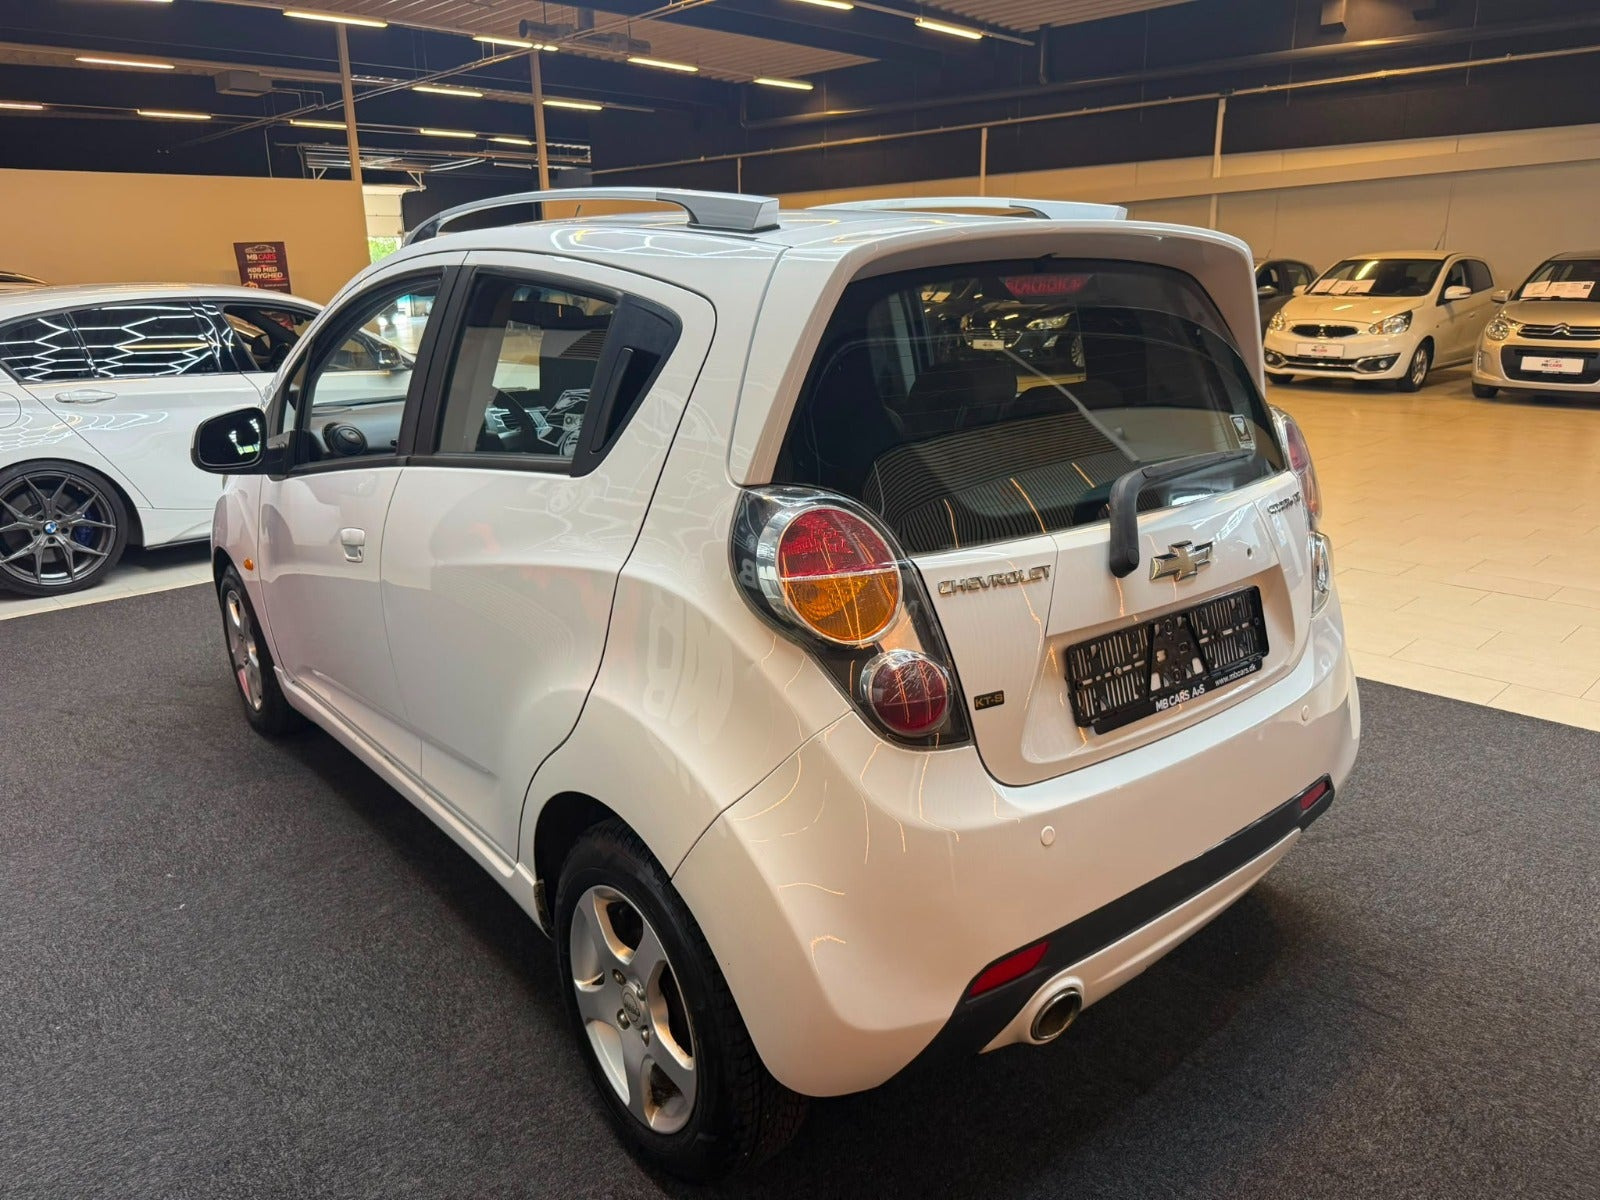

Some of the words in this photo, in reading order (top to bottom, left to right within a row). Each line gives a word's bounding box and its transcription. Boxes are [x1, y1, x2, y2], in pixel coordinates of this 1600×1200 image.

[937, 564, 1051, 595] CHEVROLET
[1214, 665, 1257, 687] www.mbcars.dk
[1155, 698, 1169, 712] MB
[1168, 689, 1190, 707] CARS
